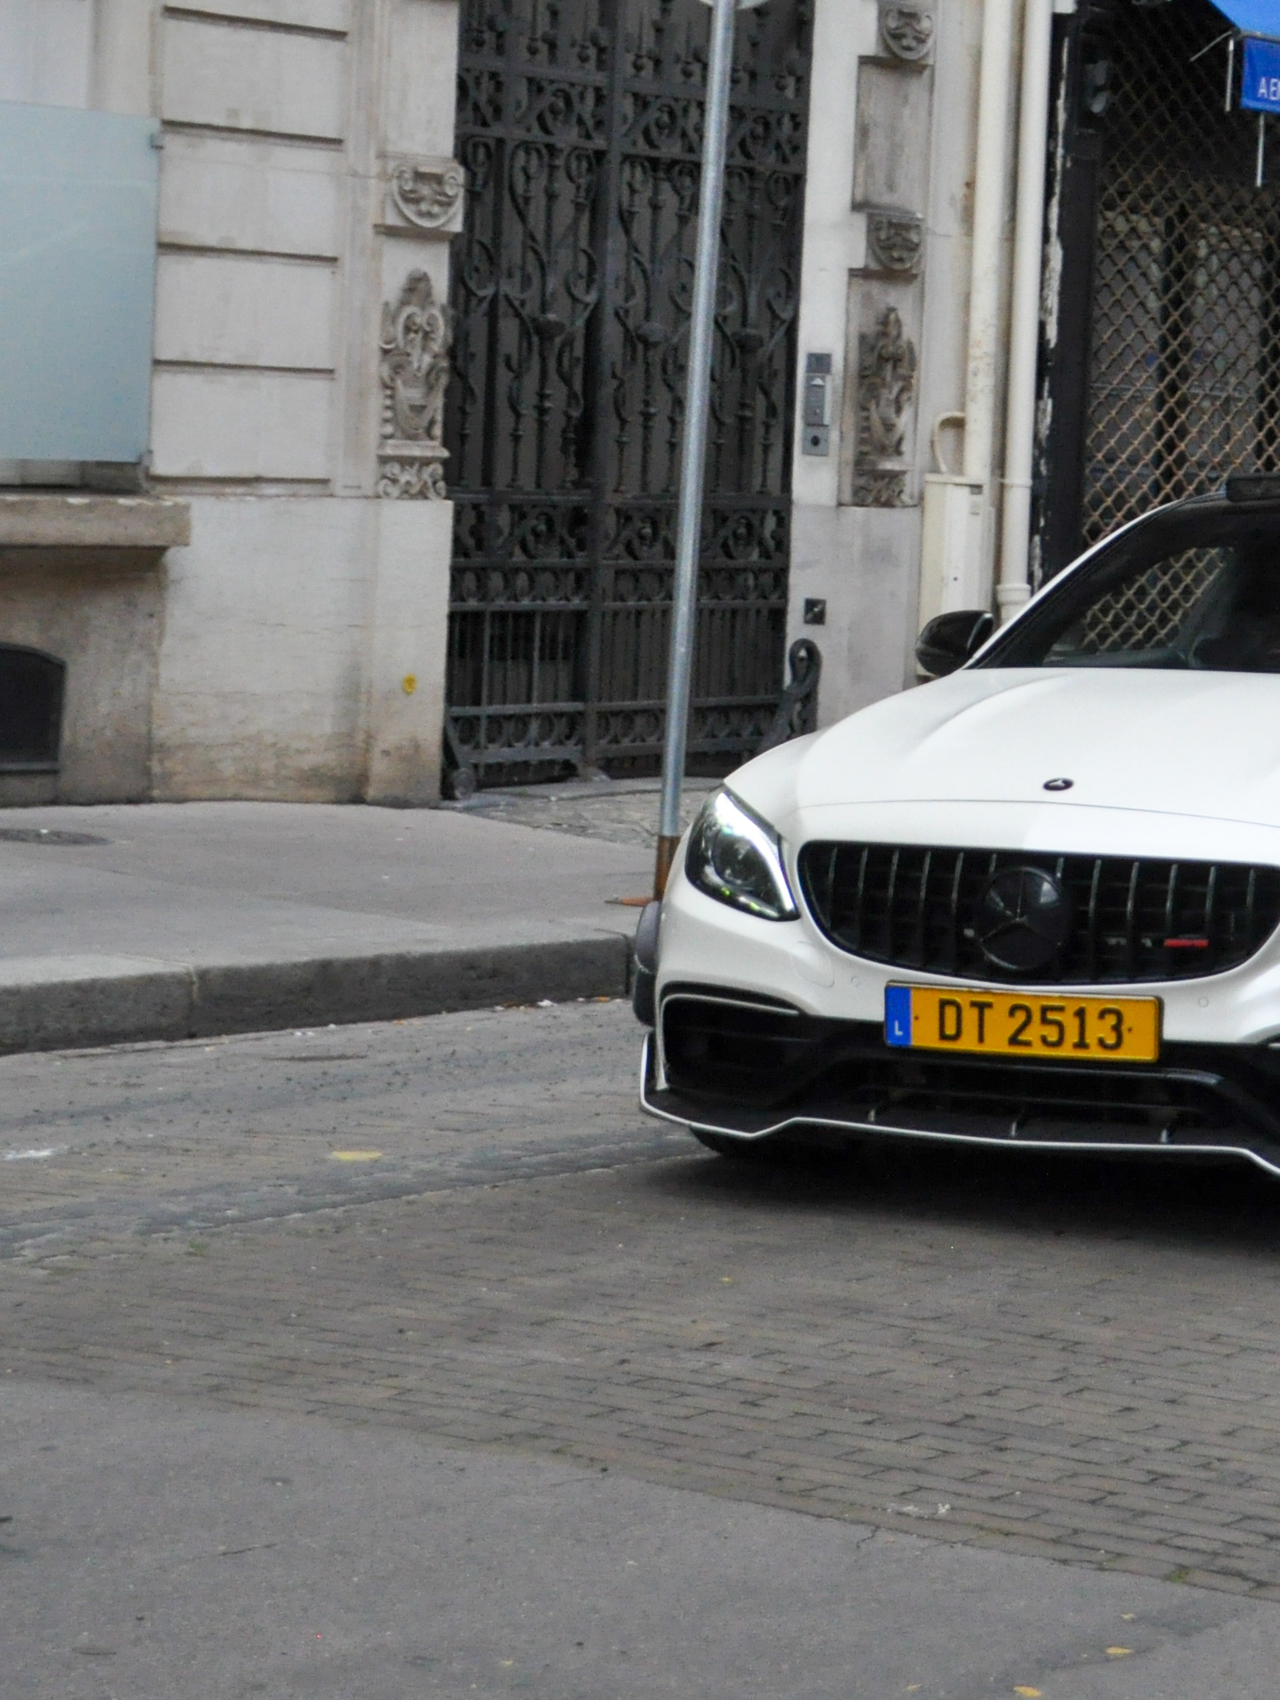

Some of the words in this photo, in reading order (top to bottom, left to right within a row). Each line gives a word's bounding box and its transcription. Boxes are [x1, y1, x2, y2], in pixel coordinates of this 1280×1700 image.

[1257, 76, 1268, 99] A
[894, 1020, 903, 1036] L
[938, 998, 993, 1044] DT
[1007, 1003, 1125, 1050] 2513
